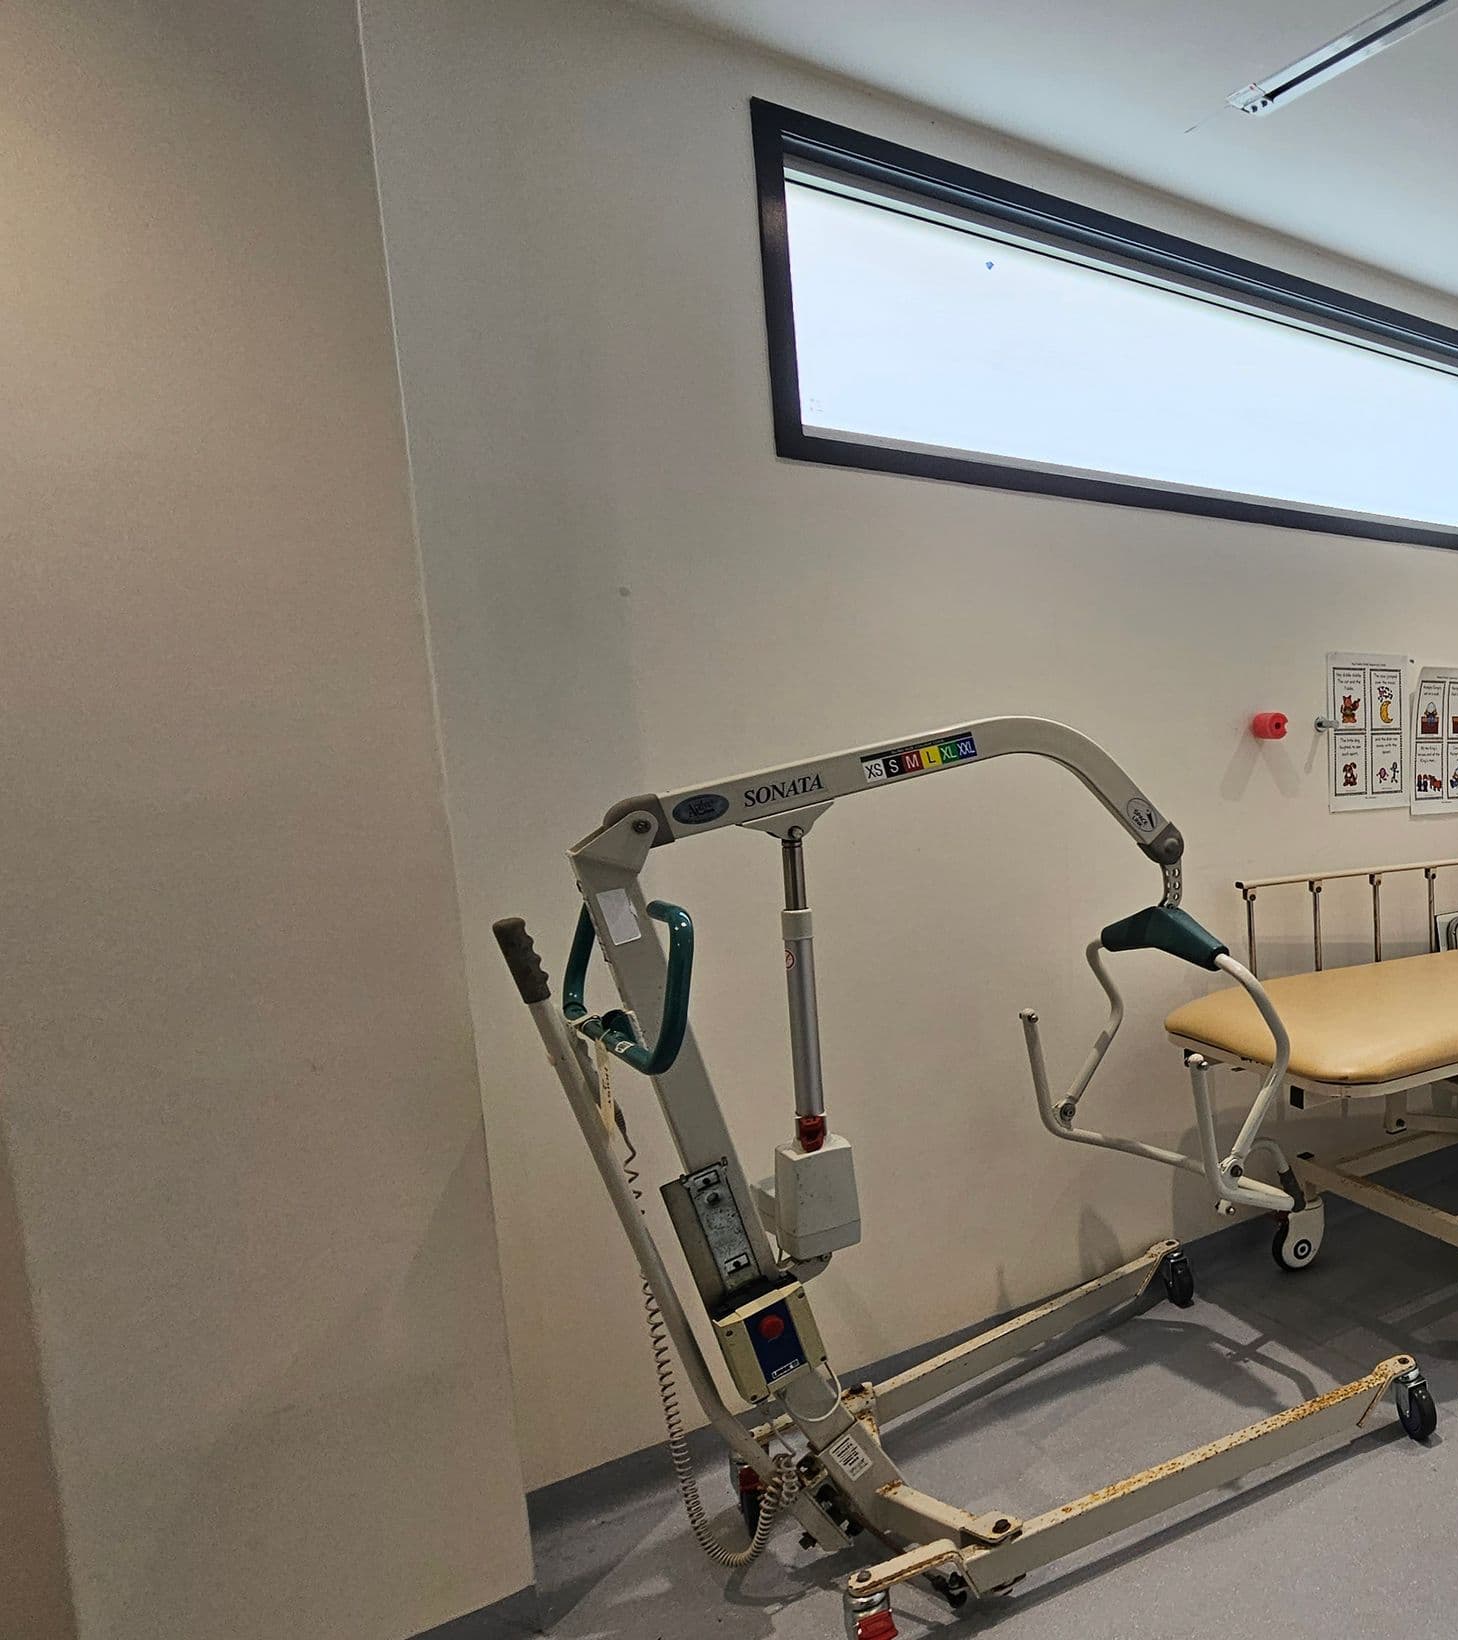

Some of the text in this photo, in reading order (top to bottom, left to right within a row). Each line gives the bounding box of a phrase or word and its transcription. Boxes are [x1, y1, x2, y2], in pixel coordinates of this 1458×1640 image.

[864, 762, 883, 779] XS
[888, 759, 900, 773] S
[905, 754, 920, 769] M
[926, 751, 936, 764] L
[940, 745, 958, 761] XL
[957, 740, 976, 755] XXL
[743, 773, 824, 808] SONATA
